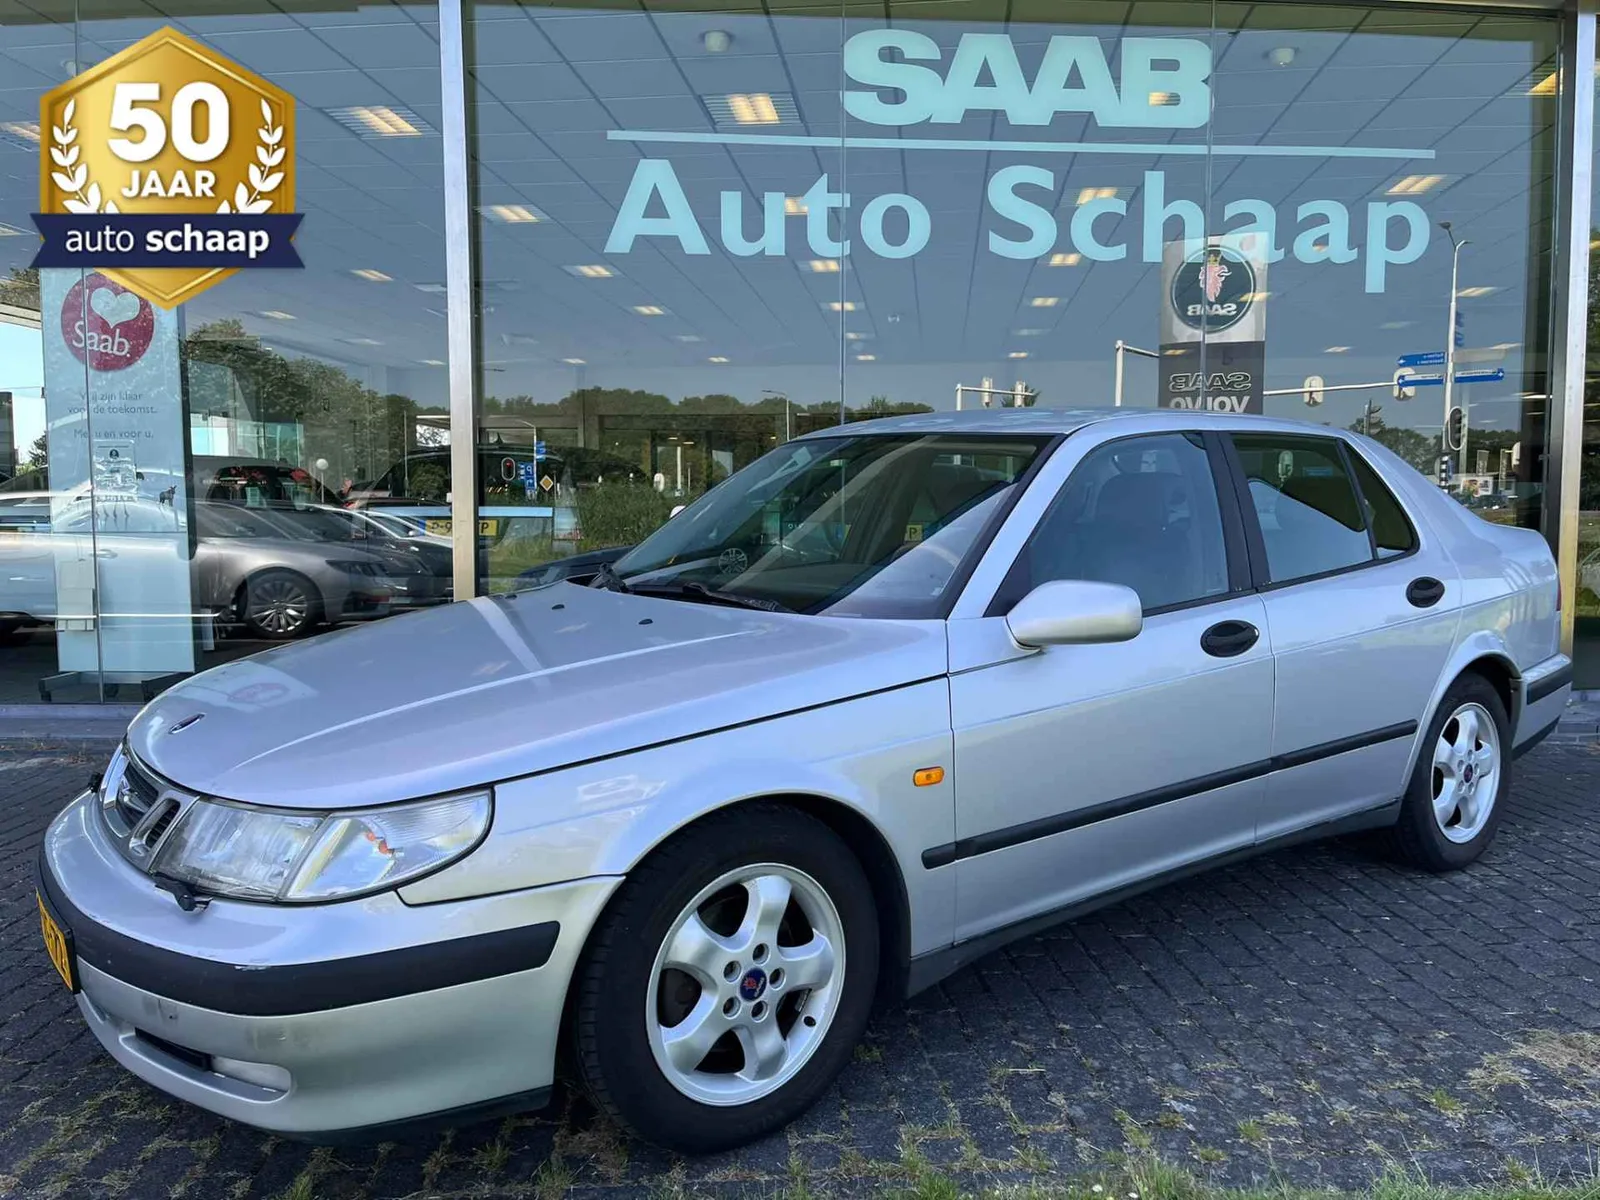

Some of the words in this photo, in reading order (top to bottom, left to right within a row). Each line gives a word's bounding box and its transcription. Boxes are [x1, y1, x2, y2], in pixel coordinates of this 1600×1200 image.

[843, 29, 1213, 129] SAAB
[604, 159, 931, 259] Auto
[987, 165, 1431, 293] Schaap
[100, 391, 116, 402] zijn
[93, 404, 105, 414] de
[119, 430, 142, 438] voor
